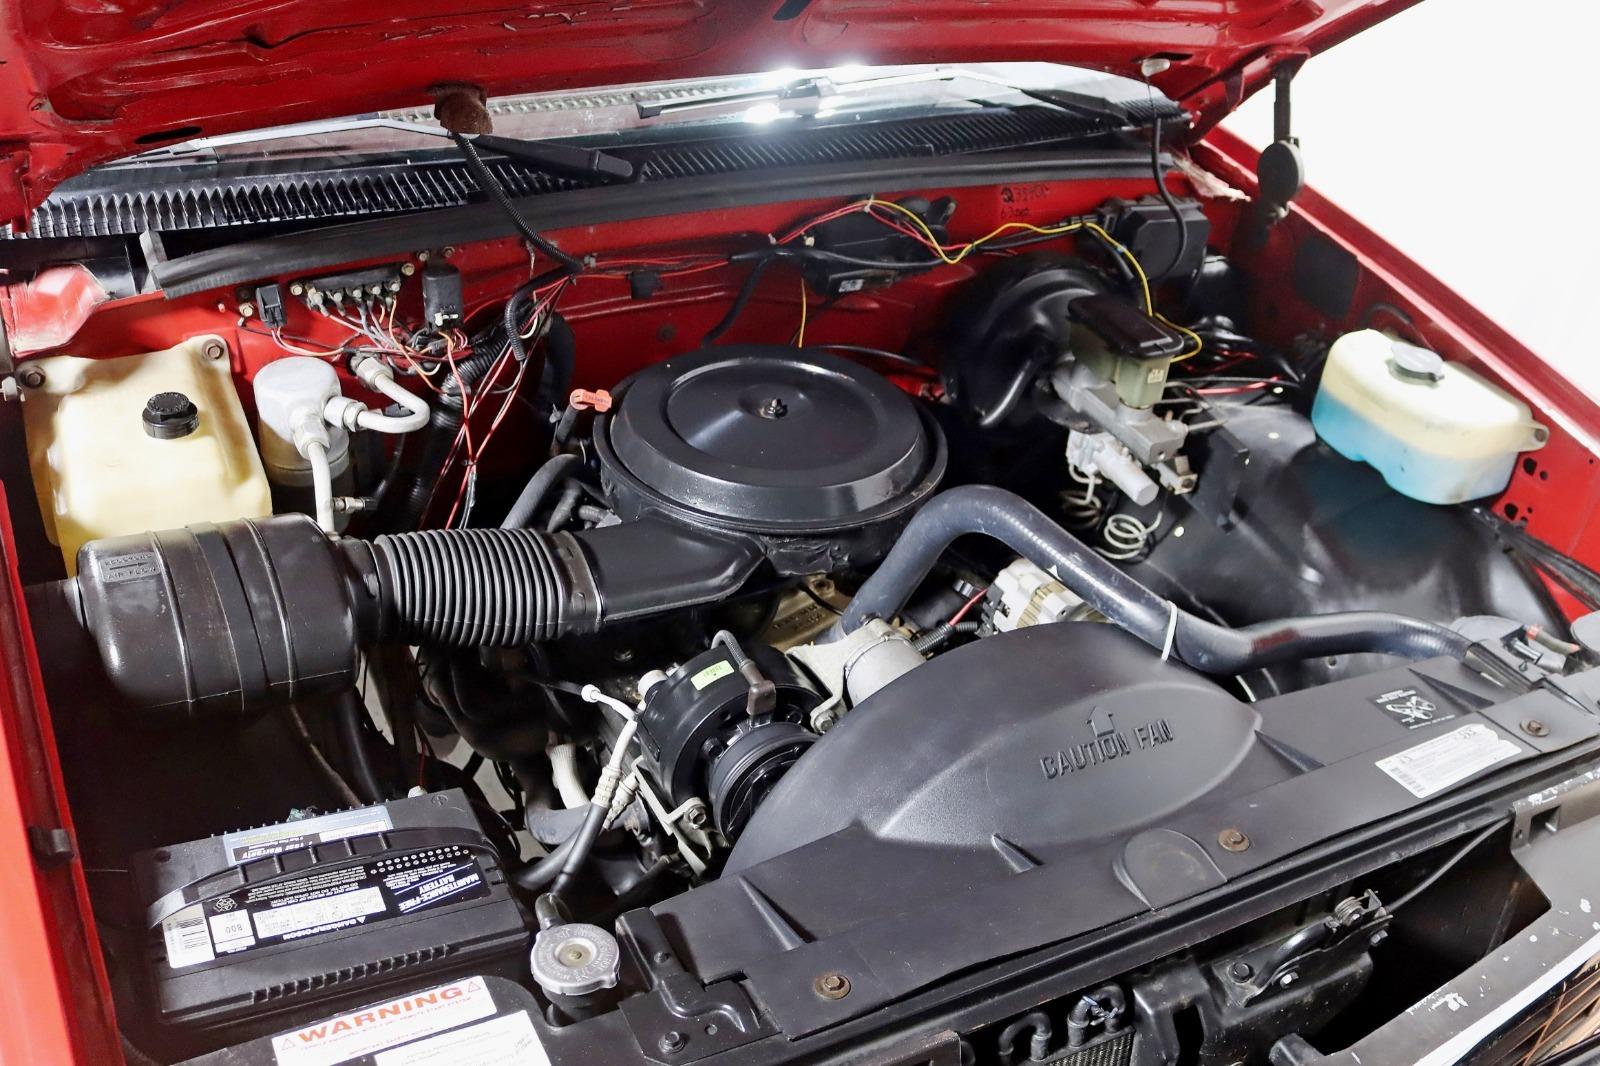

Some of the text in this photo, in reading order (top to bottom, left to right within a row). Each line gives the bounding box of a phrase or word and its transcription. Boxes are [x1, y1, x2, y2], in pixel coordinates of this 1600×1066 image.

[1040, 718, 1174, 780] CAUTION FAN
[398, 873, 480, 912] MAINTENANCE-FREE
[419, 874, 455, 894] BATTERY
[298, 986, 463, 1043] WARNING
